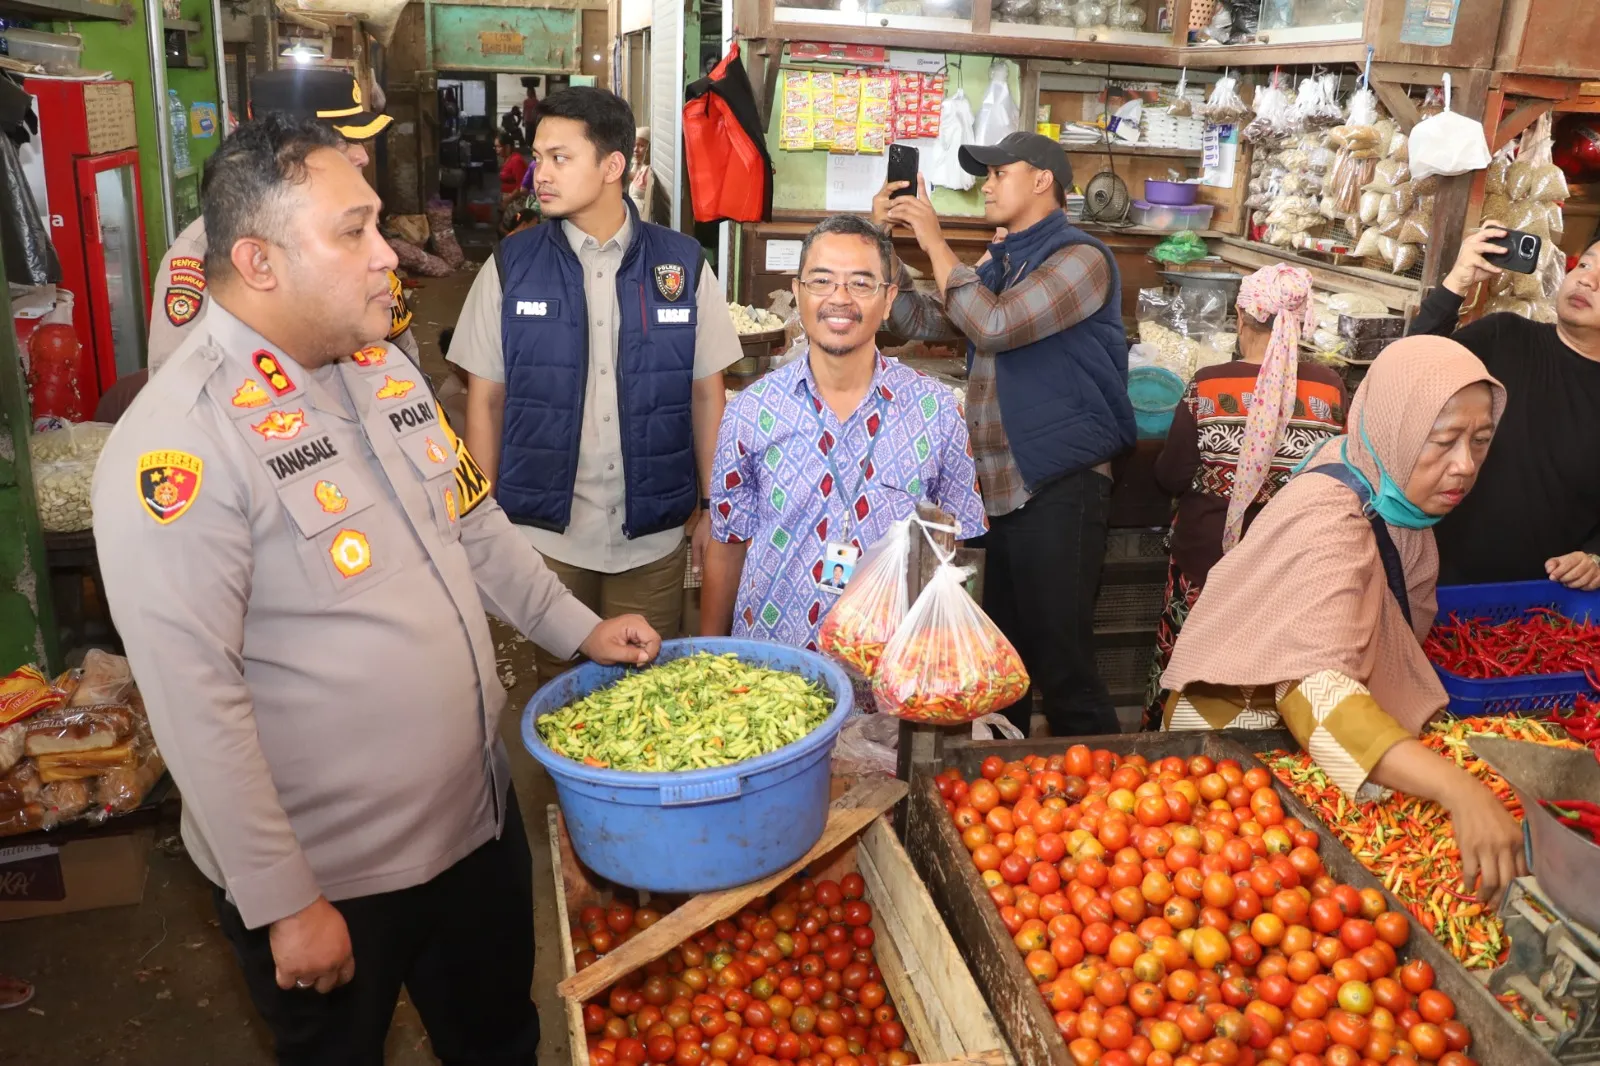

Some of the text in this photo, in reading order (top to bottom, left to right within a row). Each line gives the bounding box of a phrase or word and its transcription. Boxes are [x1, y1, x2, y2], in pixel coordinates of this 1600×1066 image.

[516, 301, 548, 316] PRAS
[388, 401, 434, 432] POLRI
[140, 452, 199, 472] RESERSE
[266, 436, 339, 480] TANASALE
